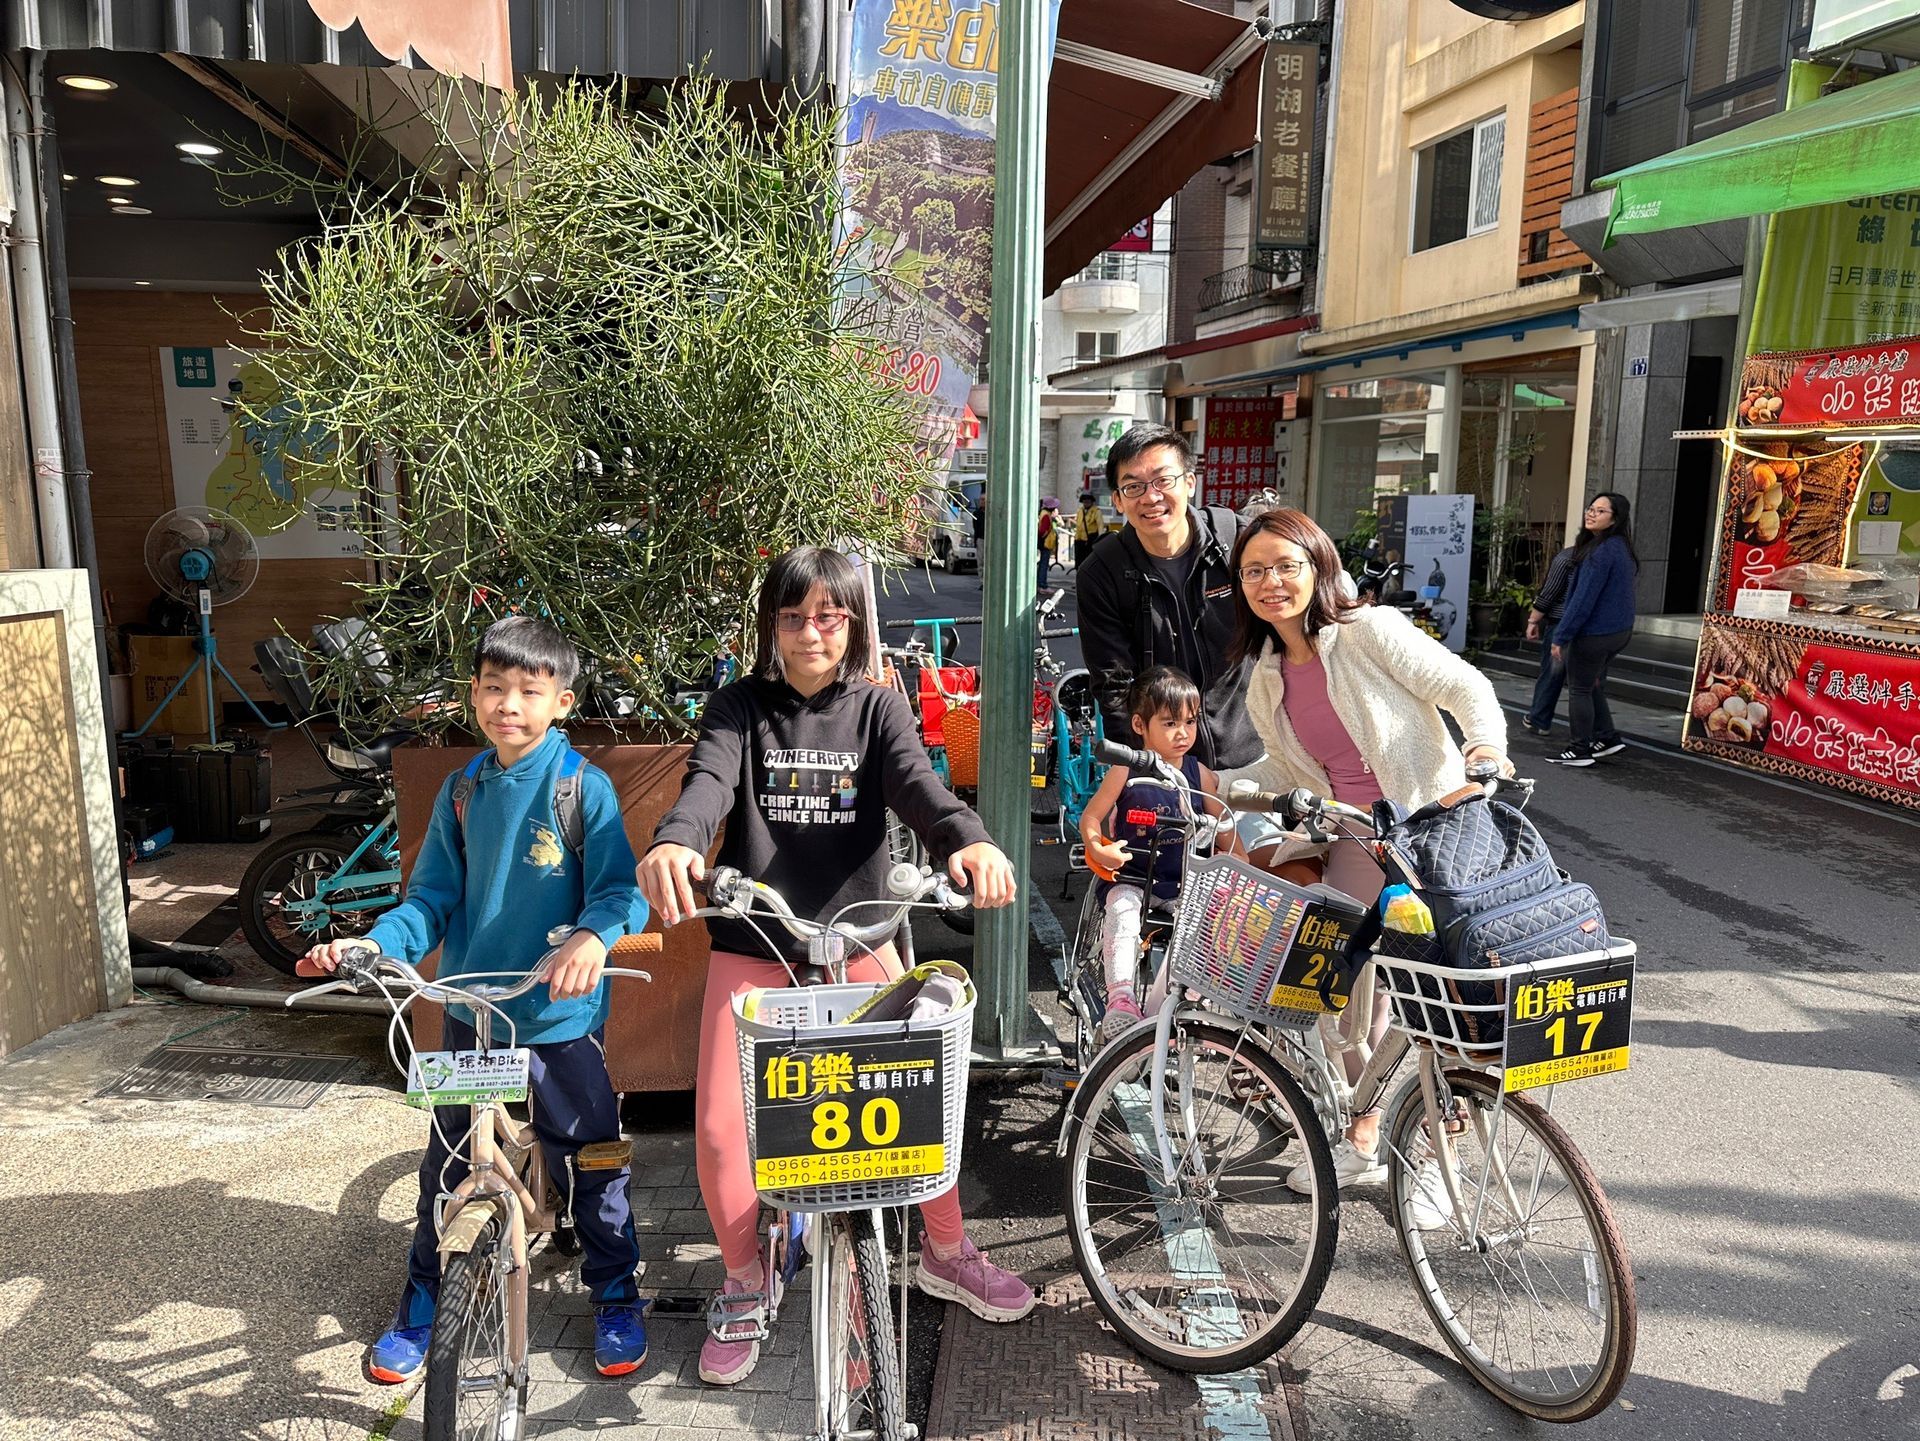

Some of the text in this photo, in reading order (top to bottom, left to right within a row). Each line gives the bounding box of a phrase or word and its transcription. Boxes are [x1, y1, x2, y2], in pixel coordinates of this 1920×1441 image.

[1270, 53, 1304, 212] 明湖老餐廳
[182, 356, 206, 367] 旅遊
[183, 368, 208, 379] 地圖
[763, 749, 859, 771] MINECRAFT
[760, 794, 830, 810] CRAFTING
[768, 809, 856, 824] SINCE ALPHA
[1298, 914, 1340, 950] 伯樂
[1513, 977, 1575, 1020] 伯樂
[1576, 986, 1627, 1008] 電動自行車
[1545, 1011, 1603, 1057] 17
[763, 1051, 855, 1100] 伯樂
[857, 1068, 935, 1091] 電動自行車
[489, 1089, 522, 1101] MT-2
[811, 1097, 901, 1150] 80
